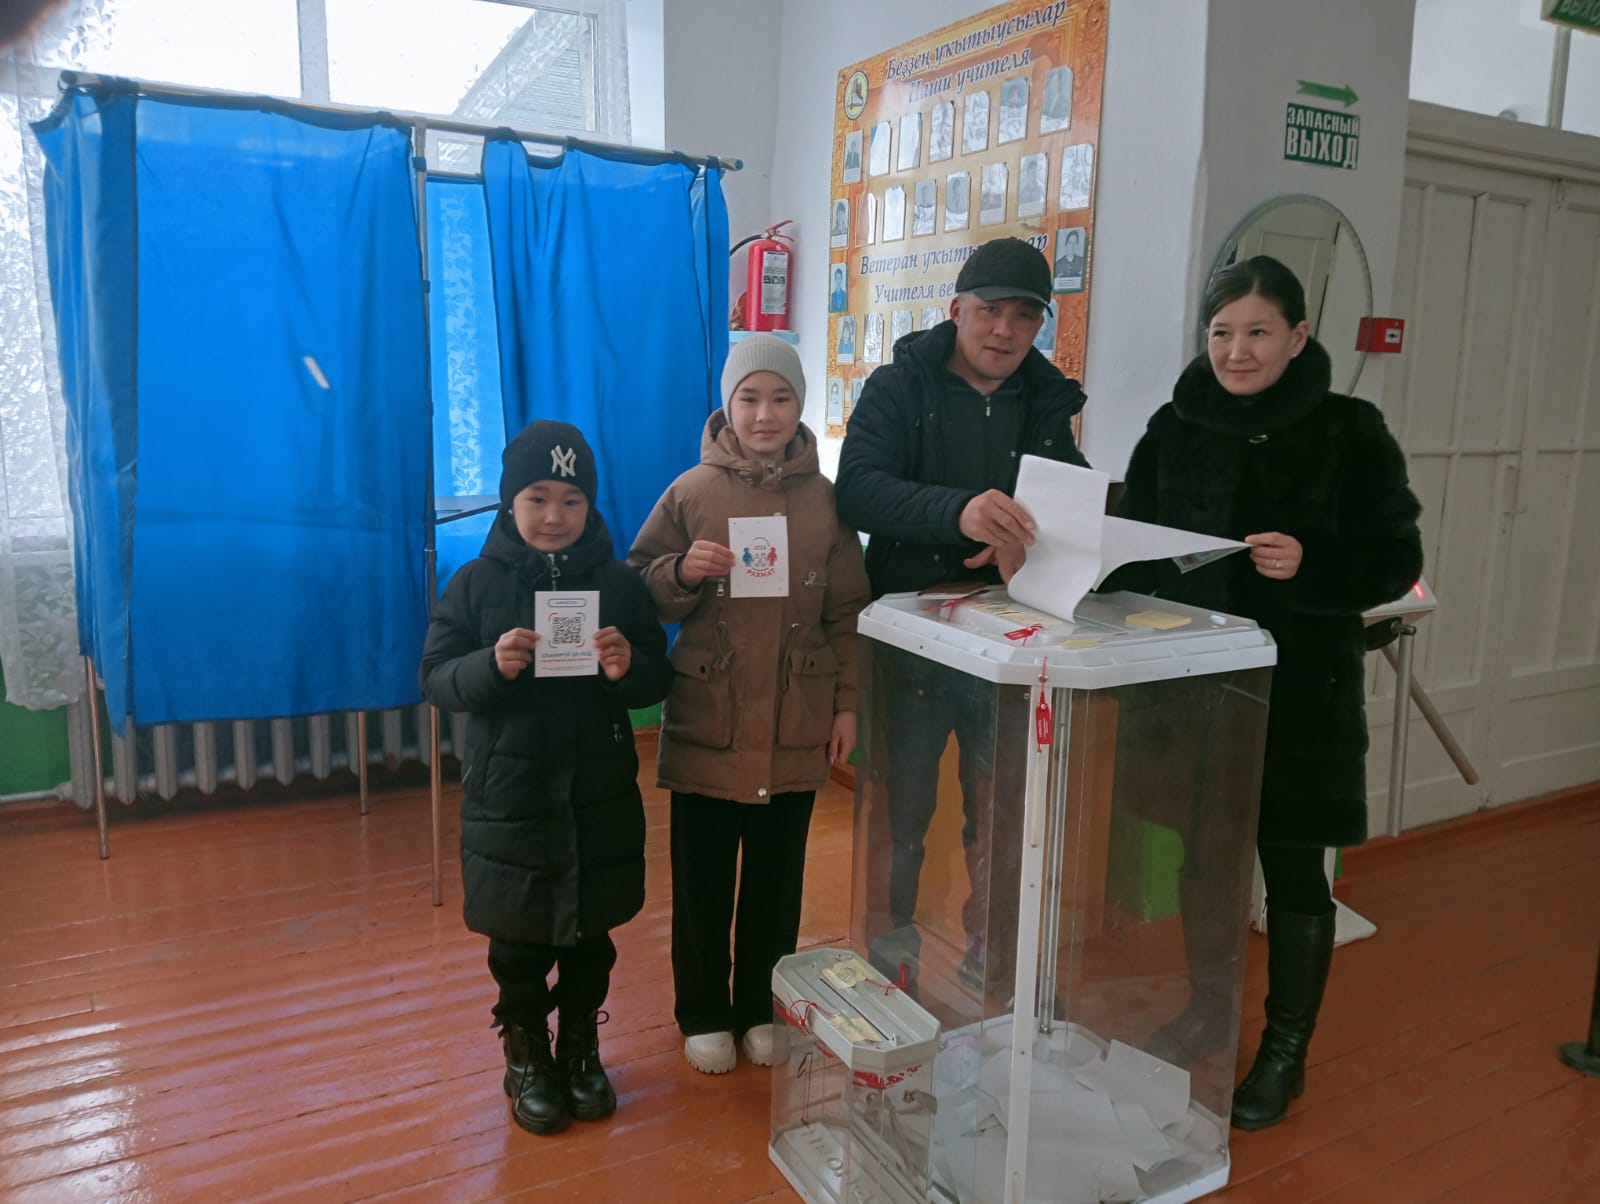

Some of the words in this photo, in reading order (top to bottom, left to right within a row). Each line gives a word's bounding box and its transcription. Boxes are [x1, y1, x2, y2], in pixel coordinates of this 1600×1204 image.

[909, 75, 952, 103] Наши
[957, 49, 1030, 94] учителя
[1287, 107, 1359, 136] ЗАПАСНЫЙ
[1286, 126, 1358, 169] ВЫХОД
[861, 254, 918, 276] Ветеран
[875, 284, 934, 304] Учителя
[551, 445, 577, 477] NY
